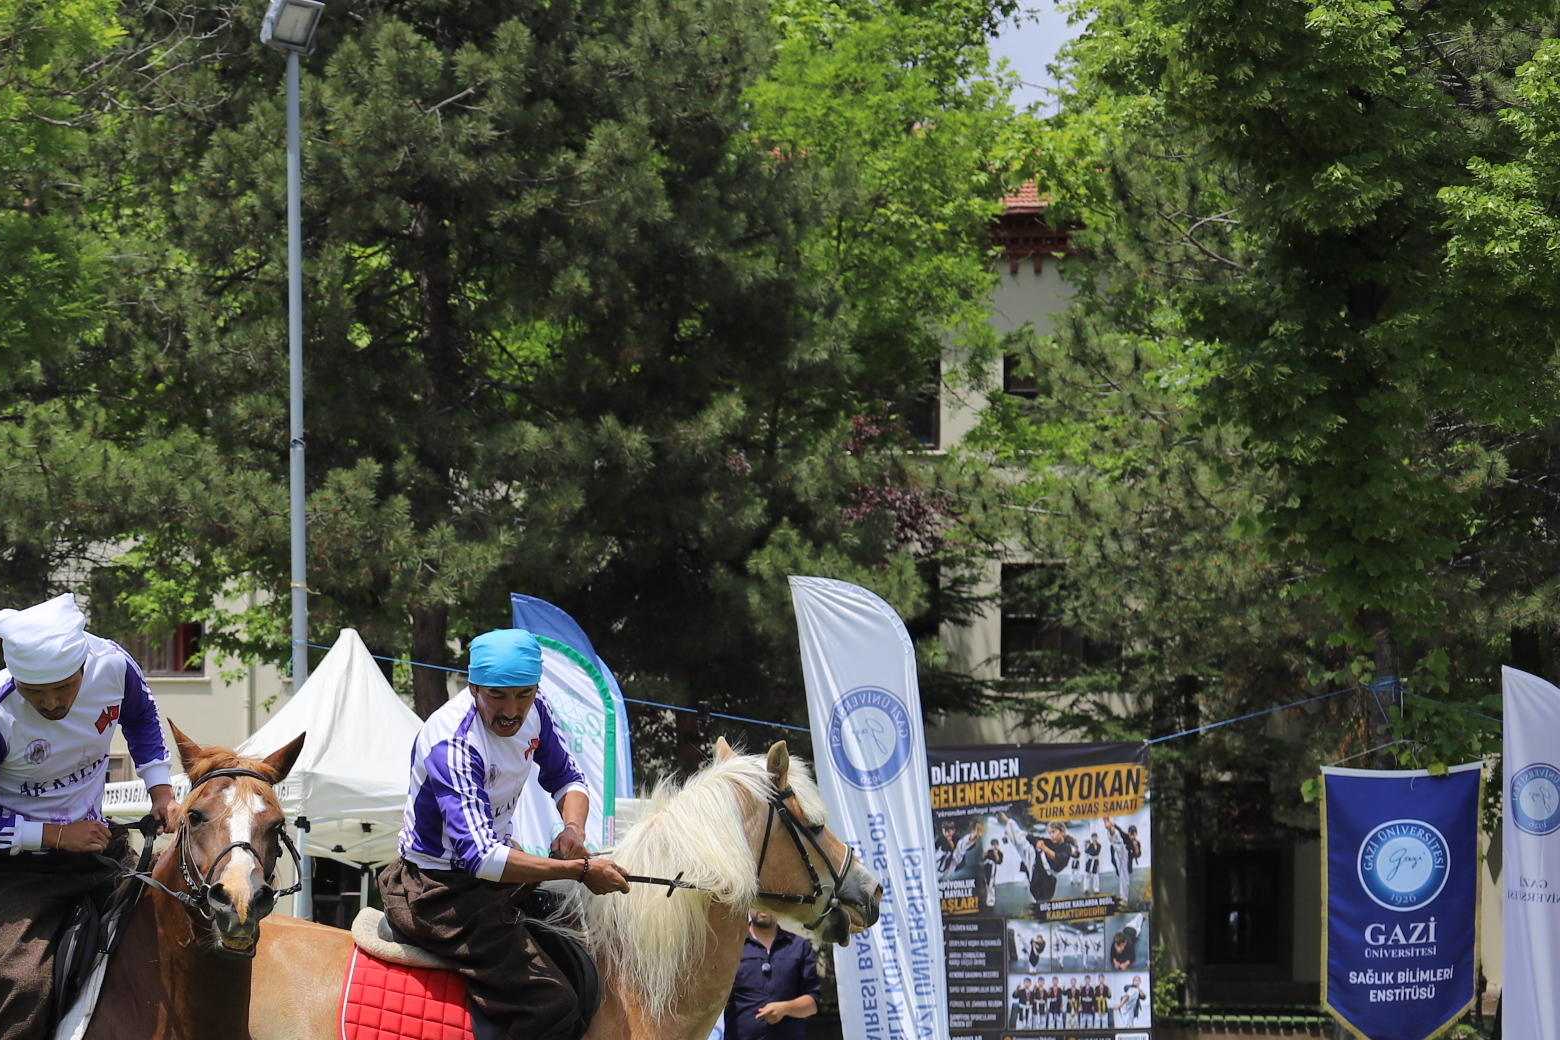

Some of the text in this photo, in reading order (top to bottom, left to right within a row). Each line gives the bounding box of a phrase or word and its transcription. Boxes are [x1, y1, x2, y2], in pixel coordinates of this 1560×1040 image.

[931, 757, 1020, 785] DİJİTALDEN
[1036, 768, 1142, 804] SAYOKAN
[1040, 799, 1138, 819] TÜRK SAVAŞ SANATI
[1363, 824, 1445, 871] GAZİ ÜNİVERSİTESİ
[941, 896, 979, 912] AŞLAR!
[1391, 893, 1417, 905] 1926
[1364, 916, 1438, 946] GAZİ
[1364, 945, 1437, 959] ÜNİVERSİTESİ
[1349, 964, 1455, 985] SAĞLIK BİLİMLERİ
[1369, 984, 1436, 1003] ENSTİTÜSÜ
